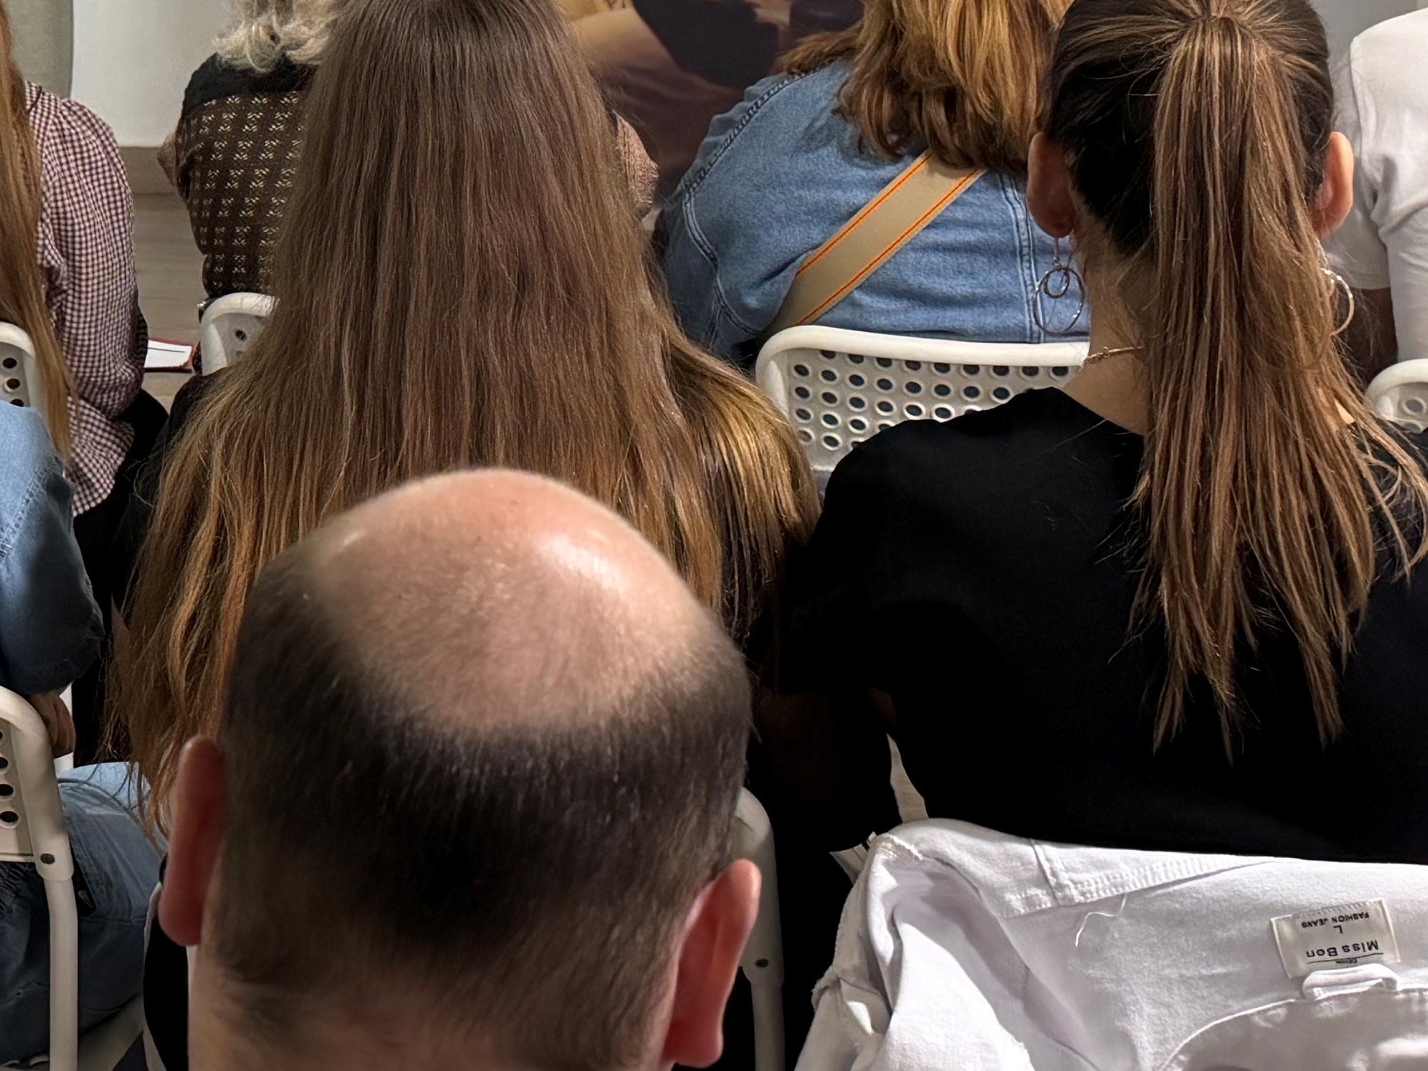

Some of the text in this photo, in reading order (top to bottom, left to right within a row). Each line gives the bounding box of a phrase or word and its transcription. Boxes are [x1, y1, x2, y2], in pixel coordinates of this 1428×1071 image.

[1301, 911, 1370, 929] FASHION JEANS
[1333, 925, 1343, 934] L
[1306, 939, 1379, 959] Miss Bon
